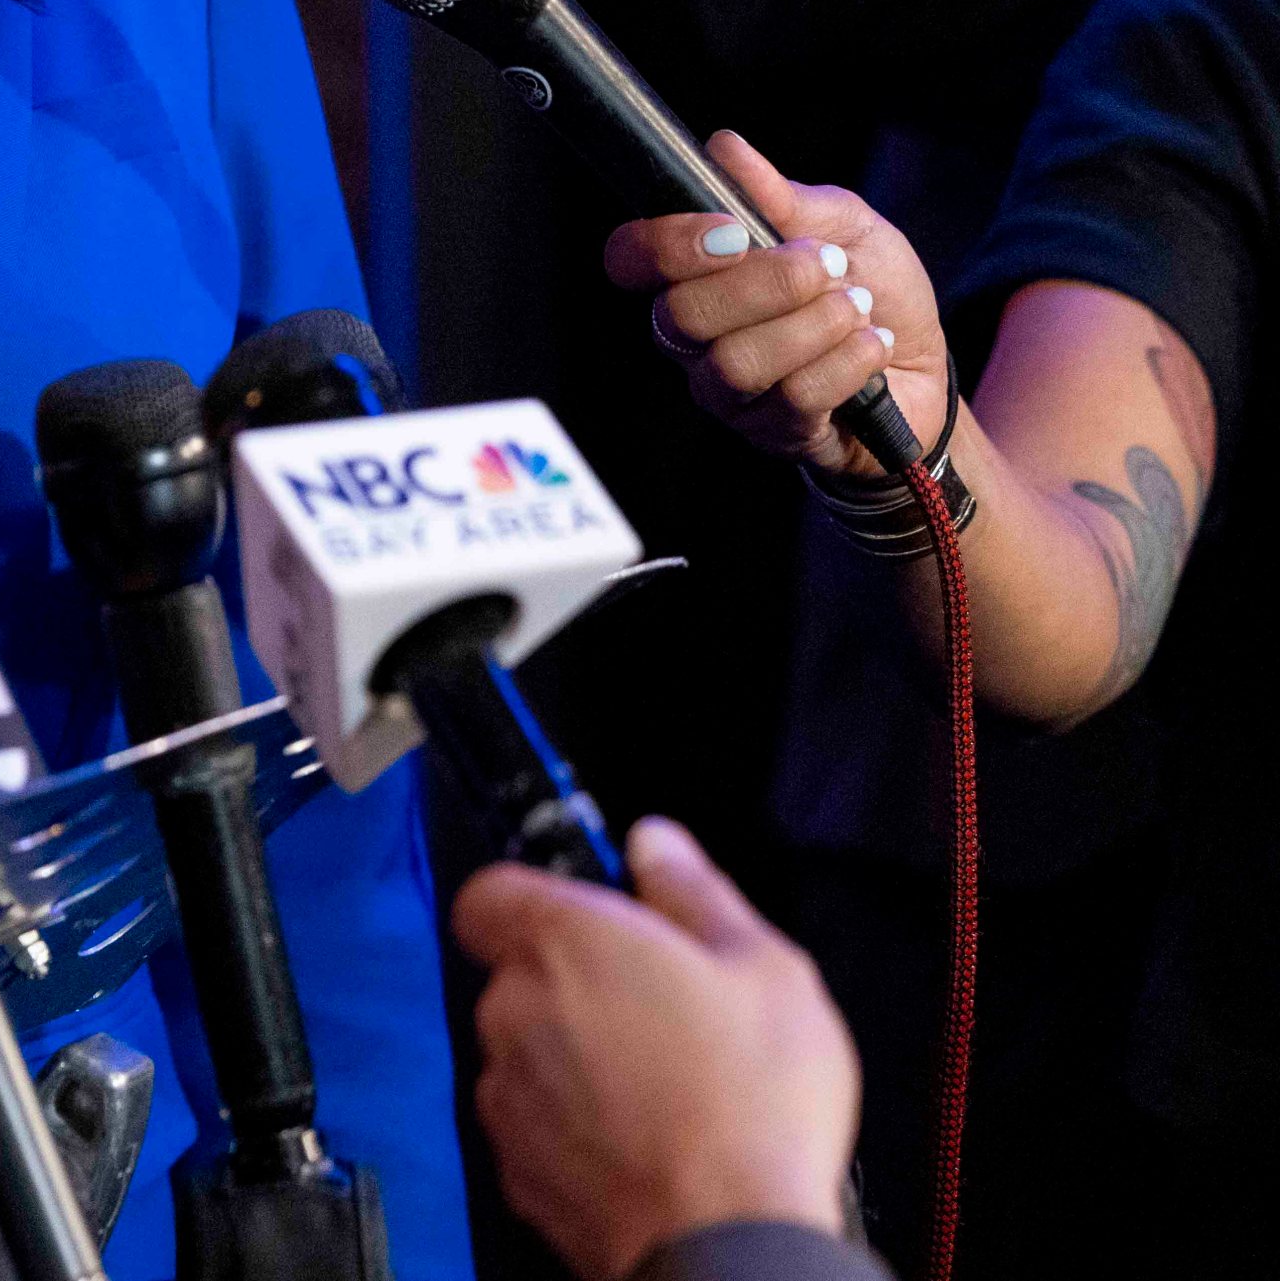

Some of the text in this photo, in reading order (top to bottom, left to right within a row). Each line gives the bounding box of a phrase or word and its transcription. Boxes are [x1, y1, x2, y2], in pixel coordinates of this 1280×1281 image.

[281, 447, 468, 519] NBC
[324, 506, 601, 558] BAY AREA
